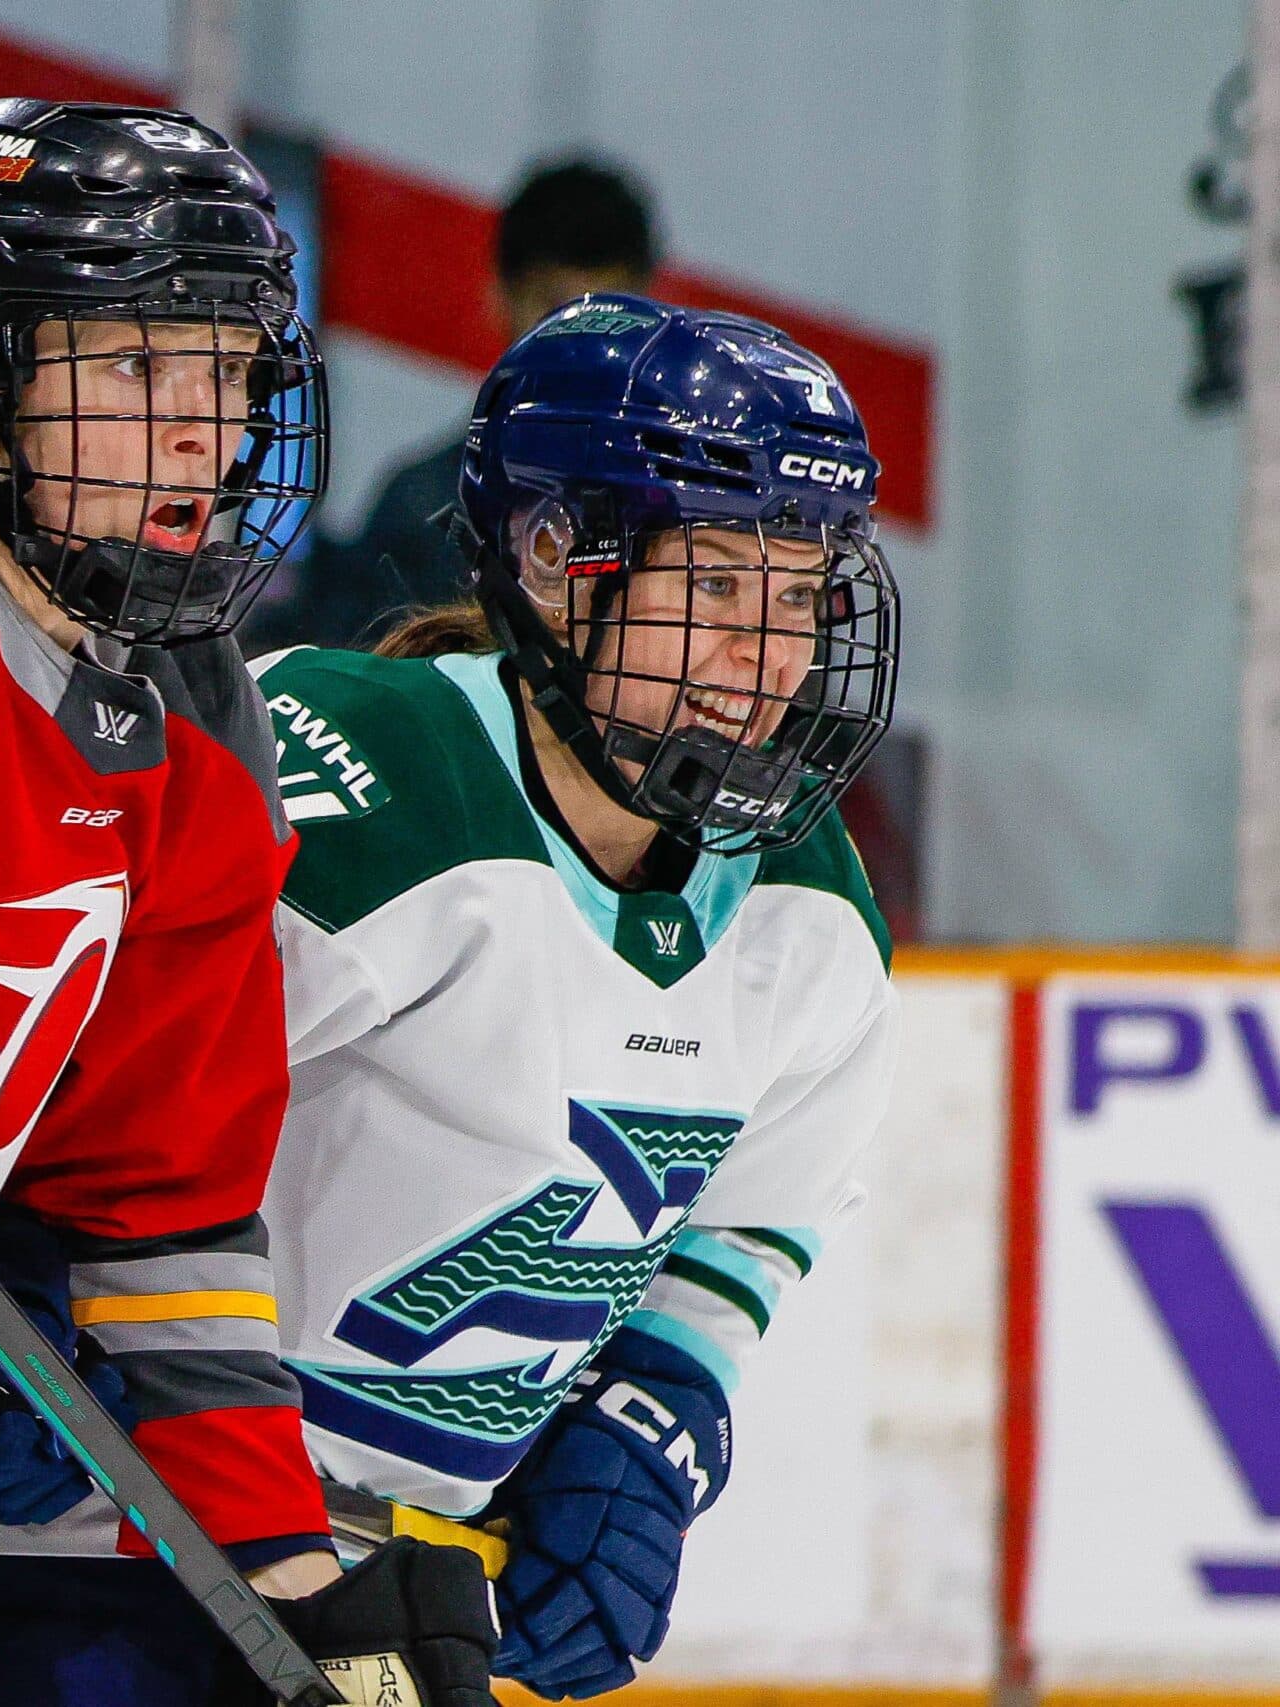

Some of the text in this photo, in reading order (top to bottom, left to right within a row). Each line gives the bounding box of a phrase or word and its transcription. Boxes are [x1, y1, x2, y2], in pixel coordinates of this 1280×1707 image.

[779, 453, 867, 490] CCM
[566, 561, 622, 577] CCM
[266, 693, 377, 809] PWHL
[713, 788, 791, 817] CCM
